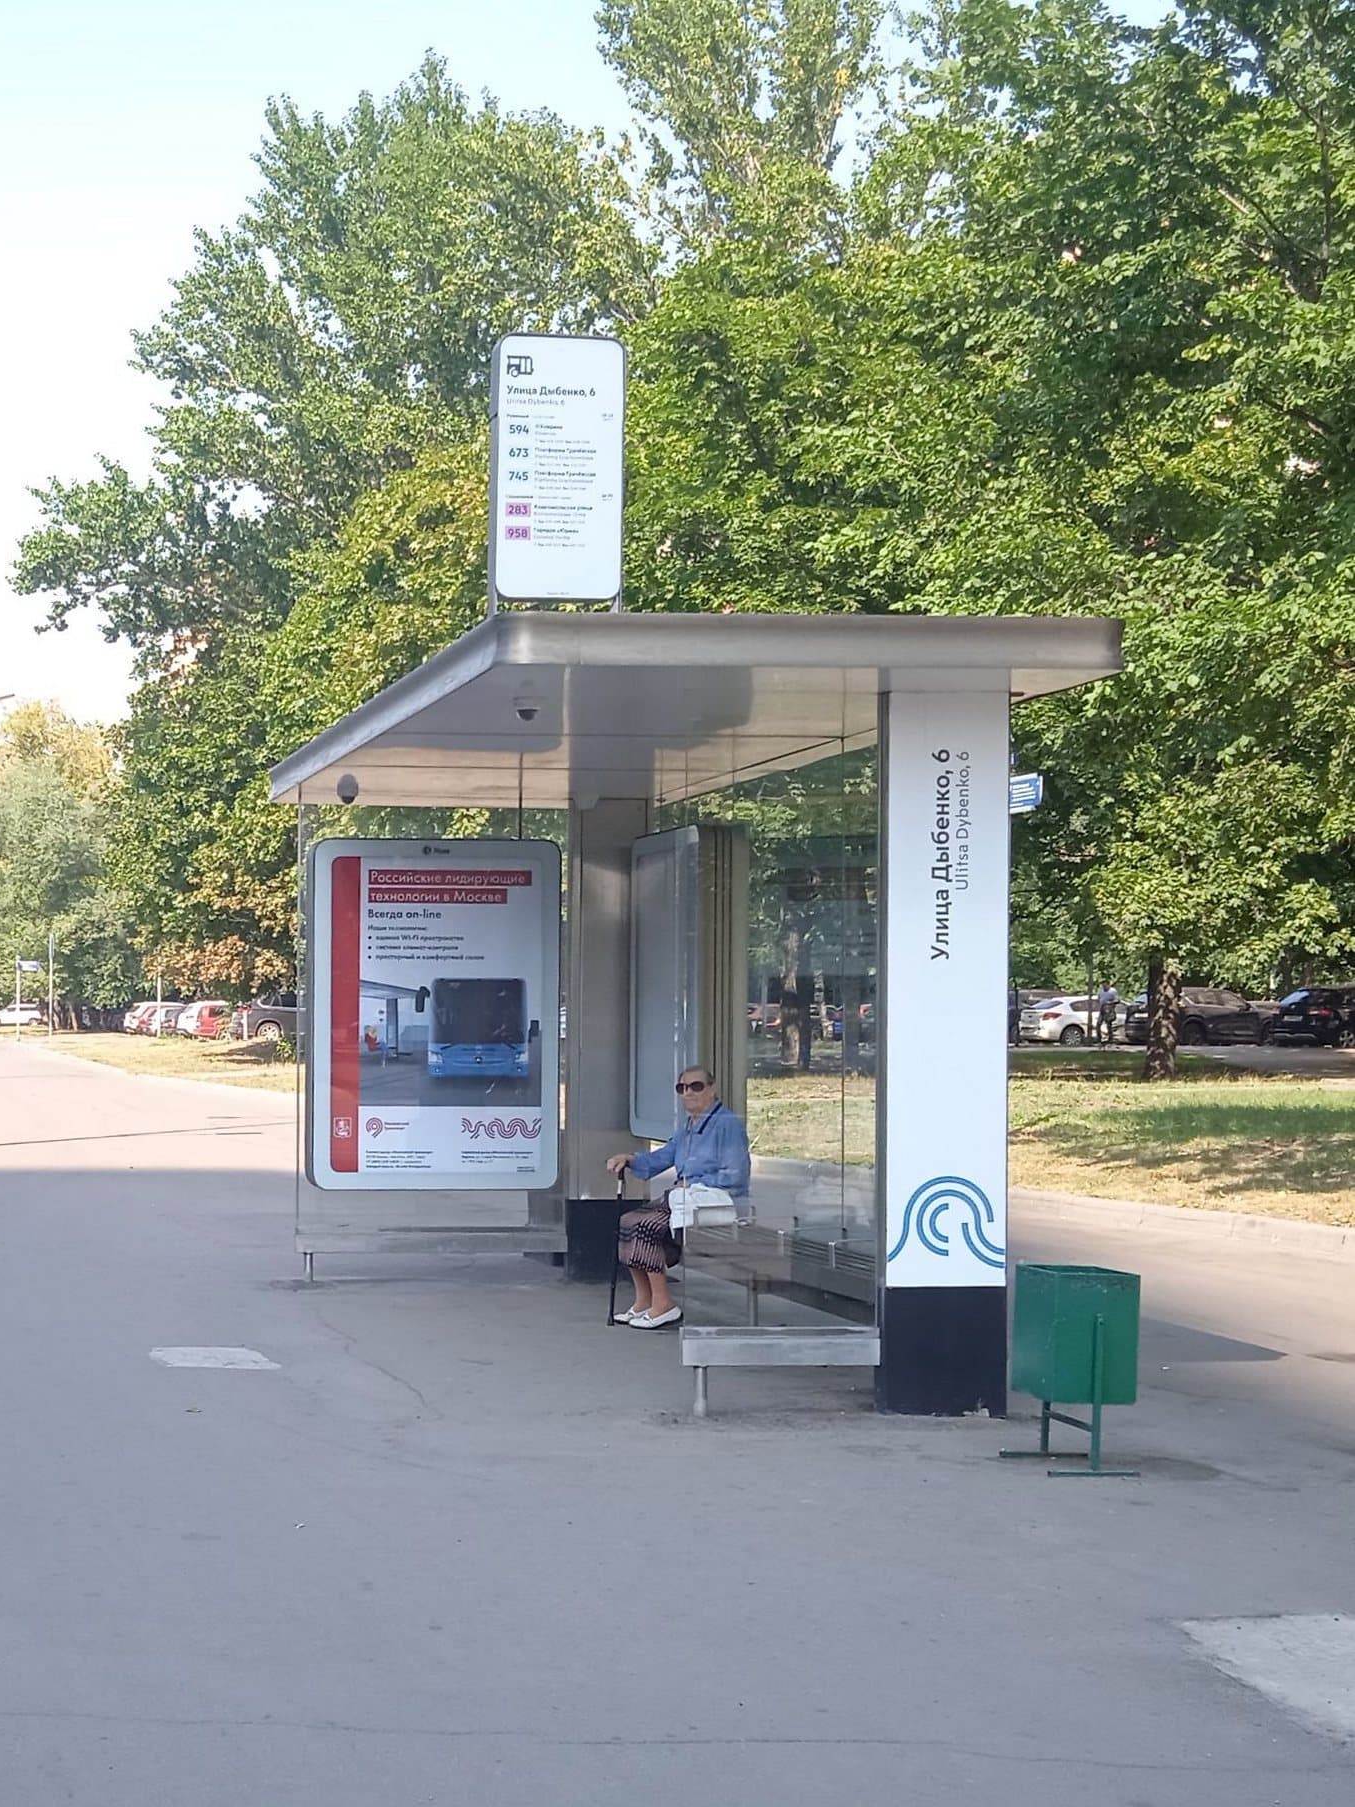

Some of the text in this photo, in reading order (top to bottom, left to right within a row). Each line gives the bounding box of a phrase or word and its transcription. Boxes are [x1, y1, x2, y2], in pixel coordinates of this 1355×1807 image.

[507, 385, 596, 397] Улица Дыбенко, 6
[509, 424, 529, 434] 594
[509, 447, 529, 458] 673
[509, 471, 529, 481] 745
[508, 505, 527, 515] 283
[508, 528, 527, 538] 958
[956, 751, 972, 890] Ulitsa Dybenko, 6
[931, 749, 954, 960] Улица Дыбенко, 6
[370, 871, 525, 886] Российские лидирующие
[370, 892, 440, 902] технологии
[453, 891, 502, 902] Москве
[368, 909, 442, 920] Всегда on-line
